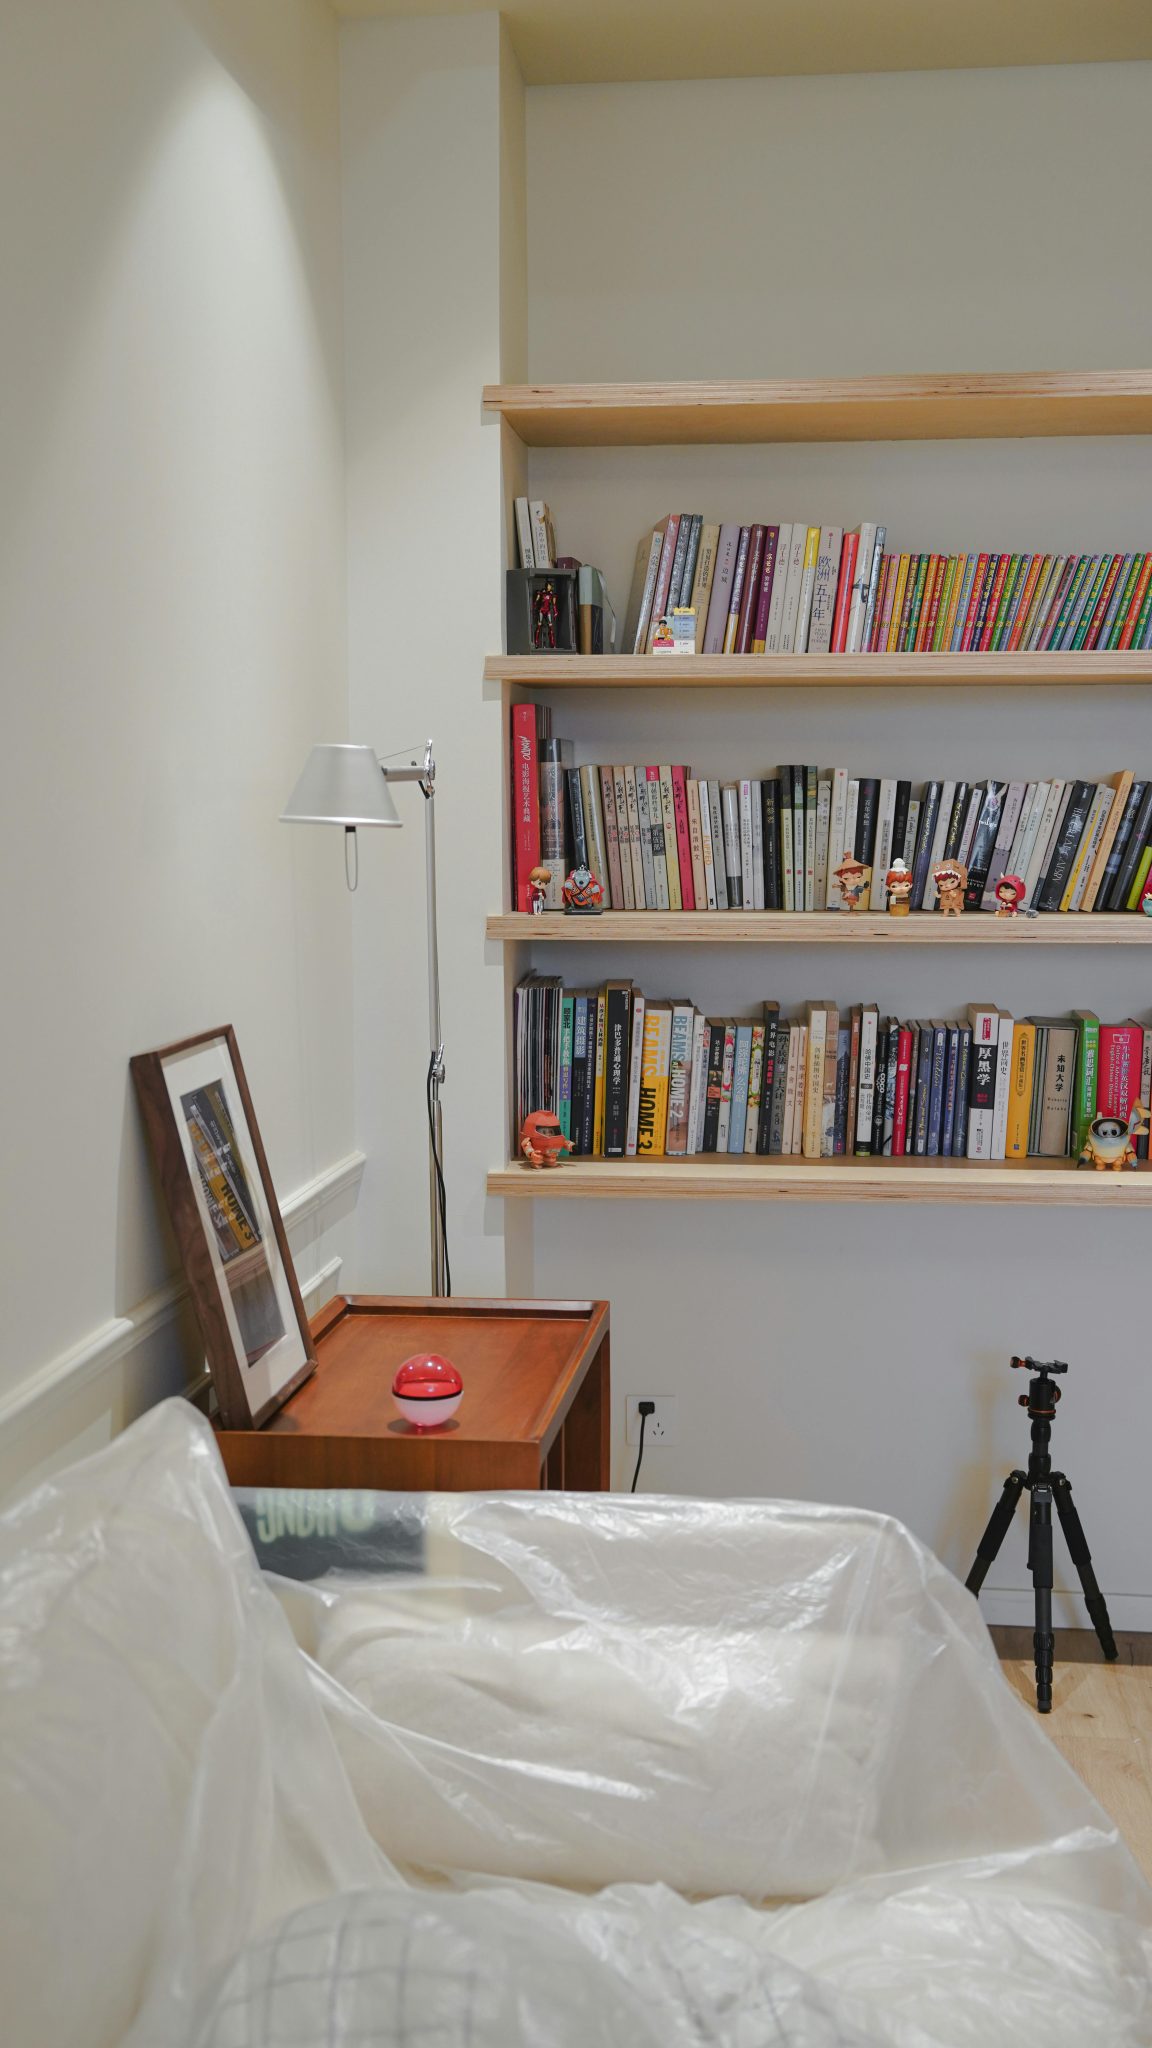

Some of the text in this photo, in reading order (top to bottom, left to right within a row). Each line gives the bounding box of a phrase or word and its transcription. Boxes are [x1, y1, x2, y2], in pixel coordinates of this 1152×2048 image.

[812, 555, 832, 622] 欧洲五十年
[691, 818, 700, 861] 朱自清散文
[703, 835, 712, 865] FLIPPED
[612, 1023, 622, 1085] 津巴多普通心理学
[642, 1015, 661, 1078] BEAMS
[672, 1016, 688, 1061] BEAMS
[670, 1069, 687, 1108] HOME
[976, 1047, 992, 1086] 厚黑学
[1055, 1054, 1066, 1093] 未知大学
[1119, 1045, 1131, 1119] 牛津高阶英汉双解词典
[639, 1087, 657, 1138] HOME
[670, 1109, 684, 1119] 2
